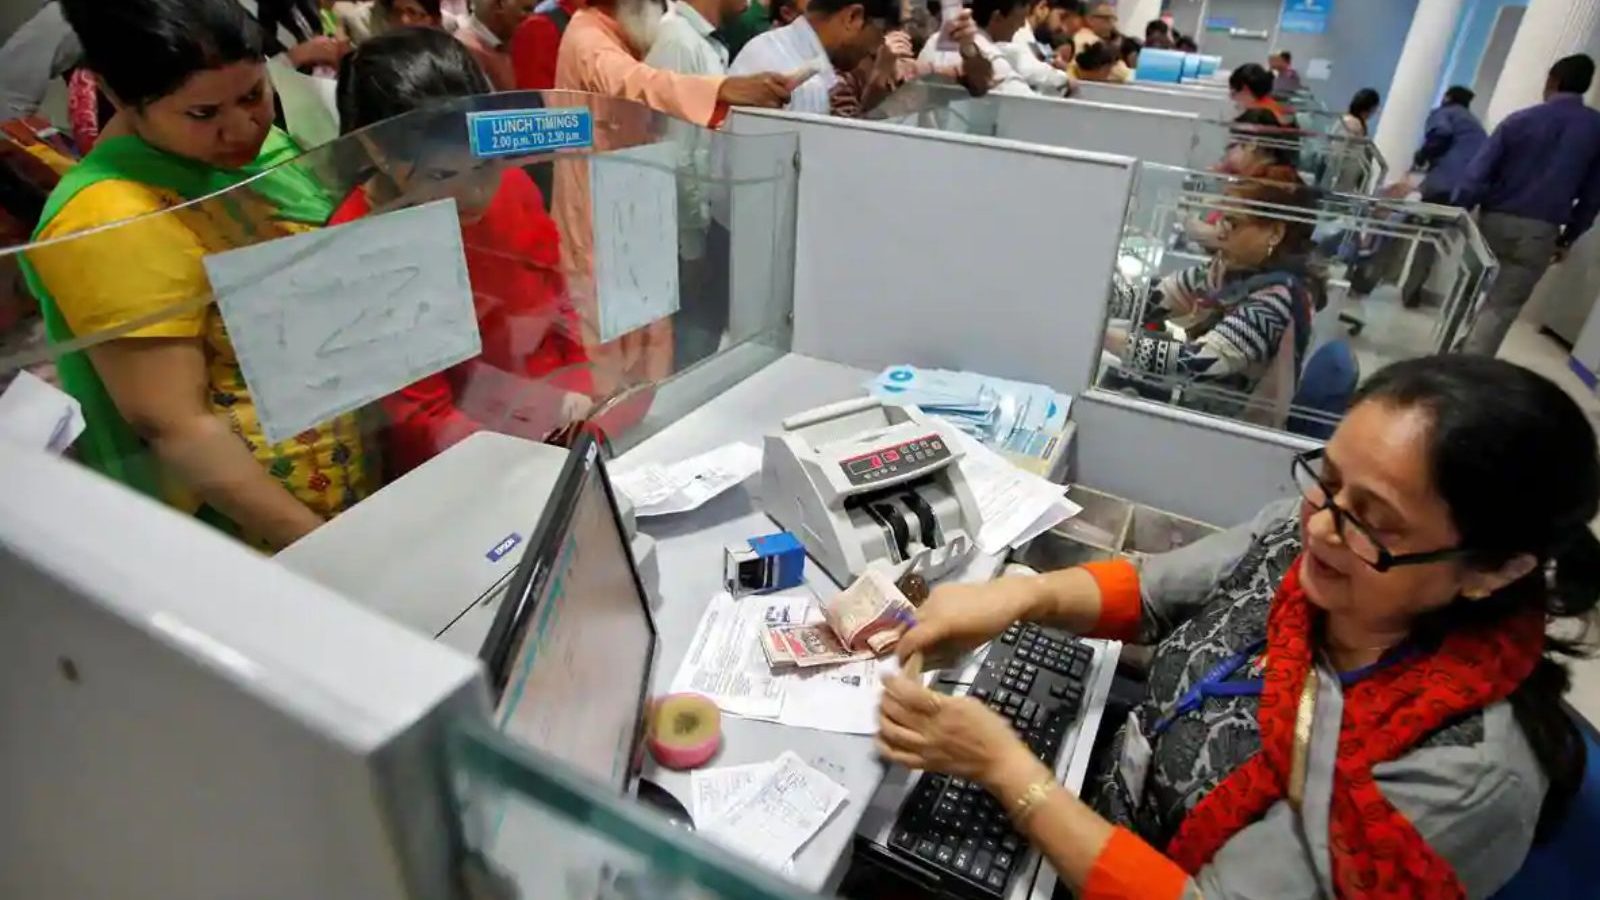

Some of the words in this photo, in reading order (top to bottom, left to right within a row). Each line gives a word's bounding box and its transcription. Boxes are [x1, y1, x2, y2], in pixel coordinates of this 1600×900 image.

[492, 119, 533, 134] LUNCH
[536, 115, 579, 130] TIMINGS
[492, 136, 511, 148] 2.00
[532, 133, 545, 144] TO
[494, 538, 516, 556] EPSON
